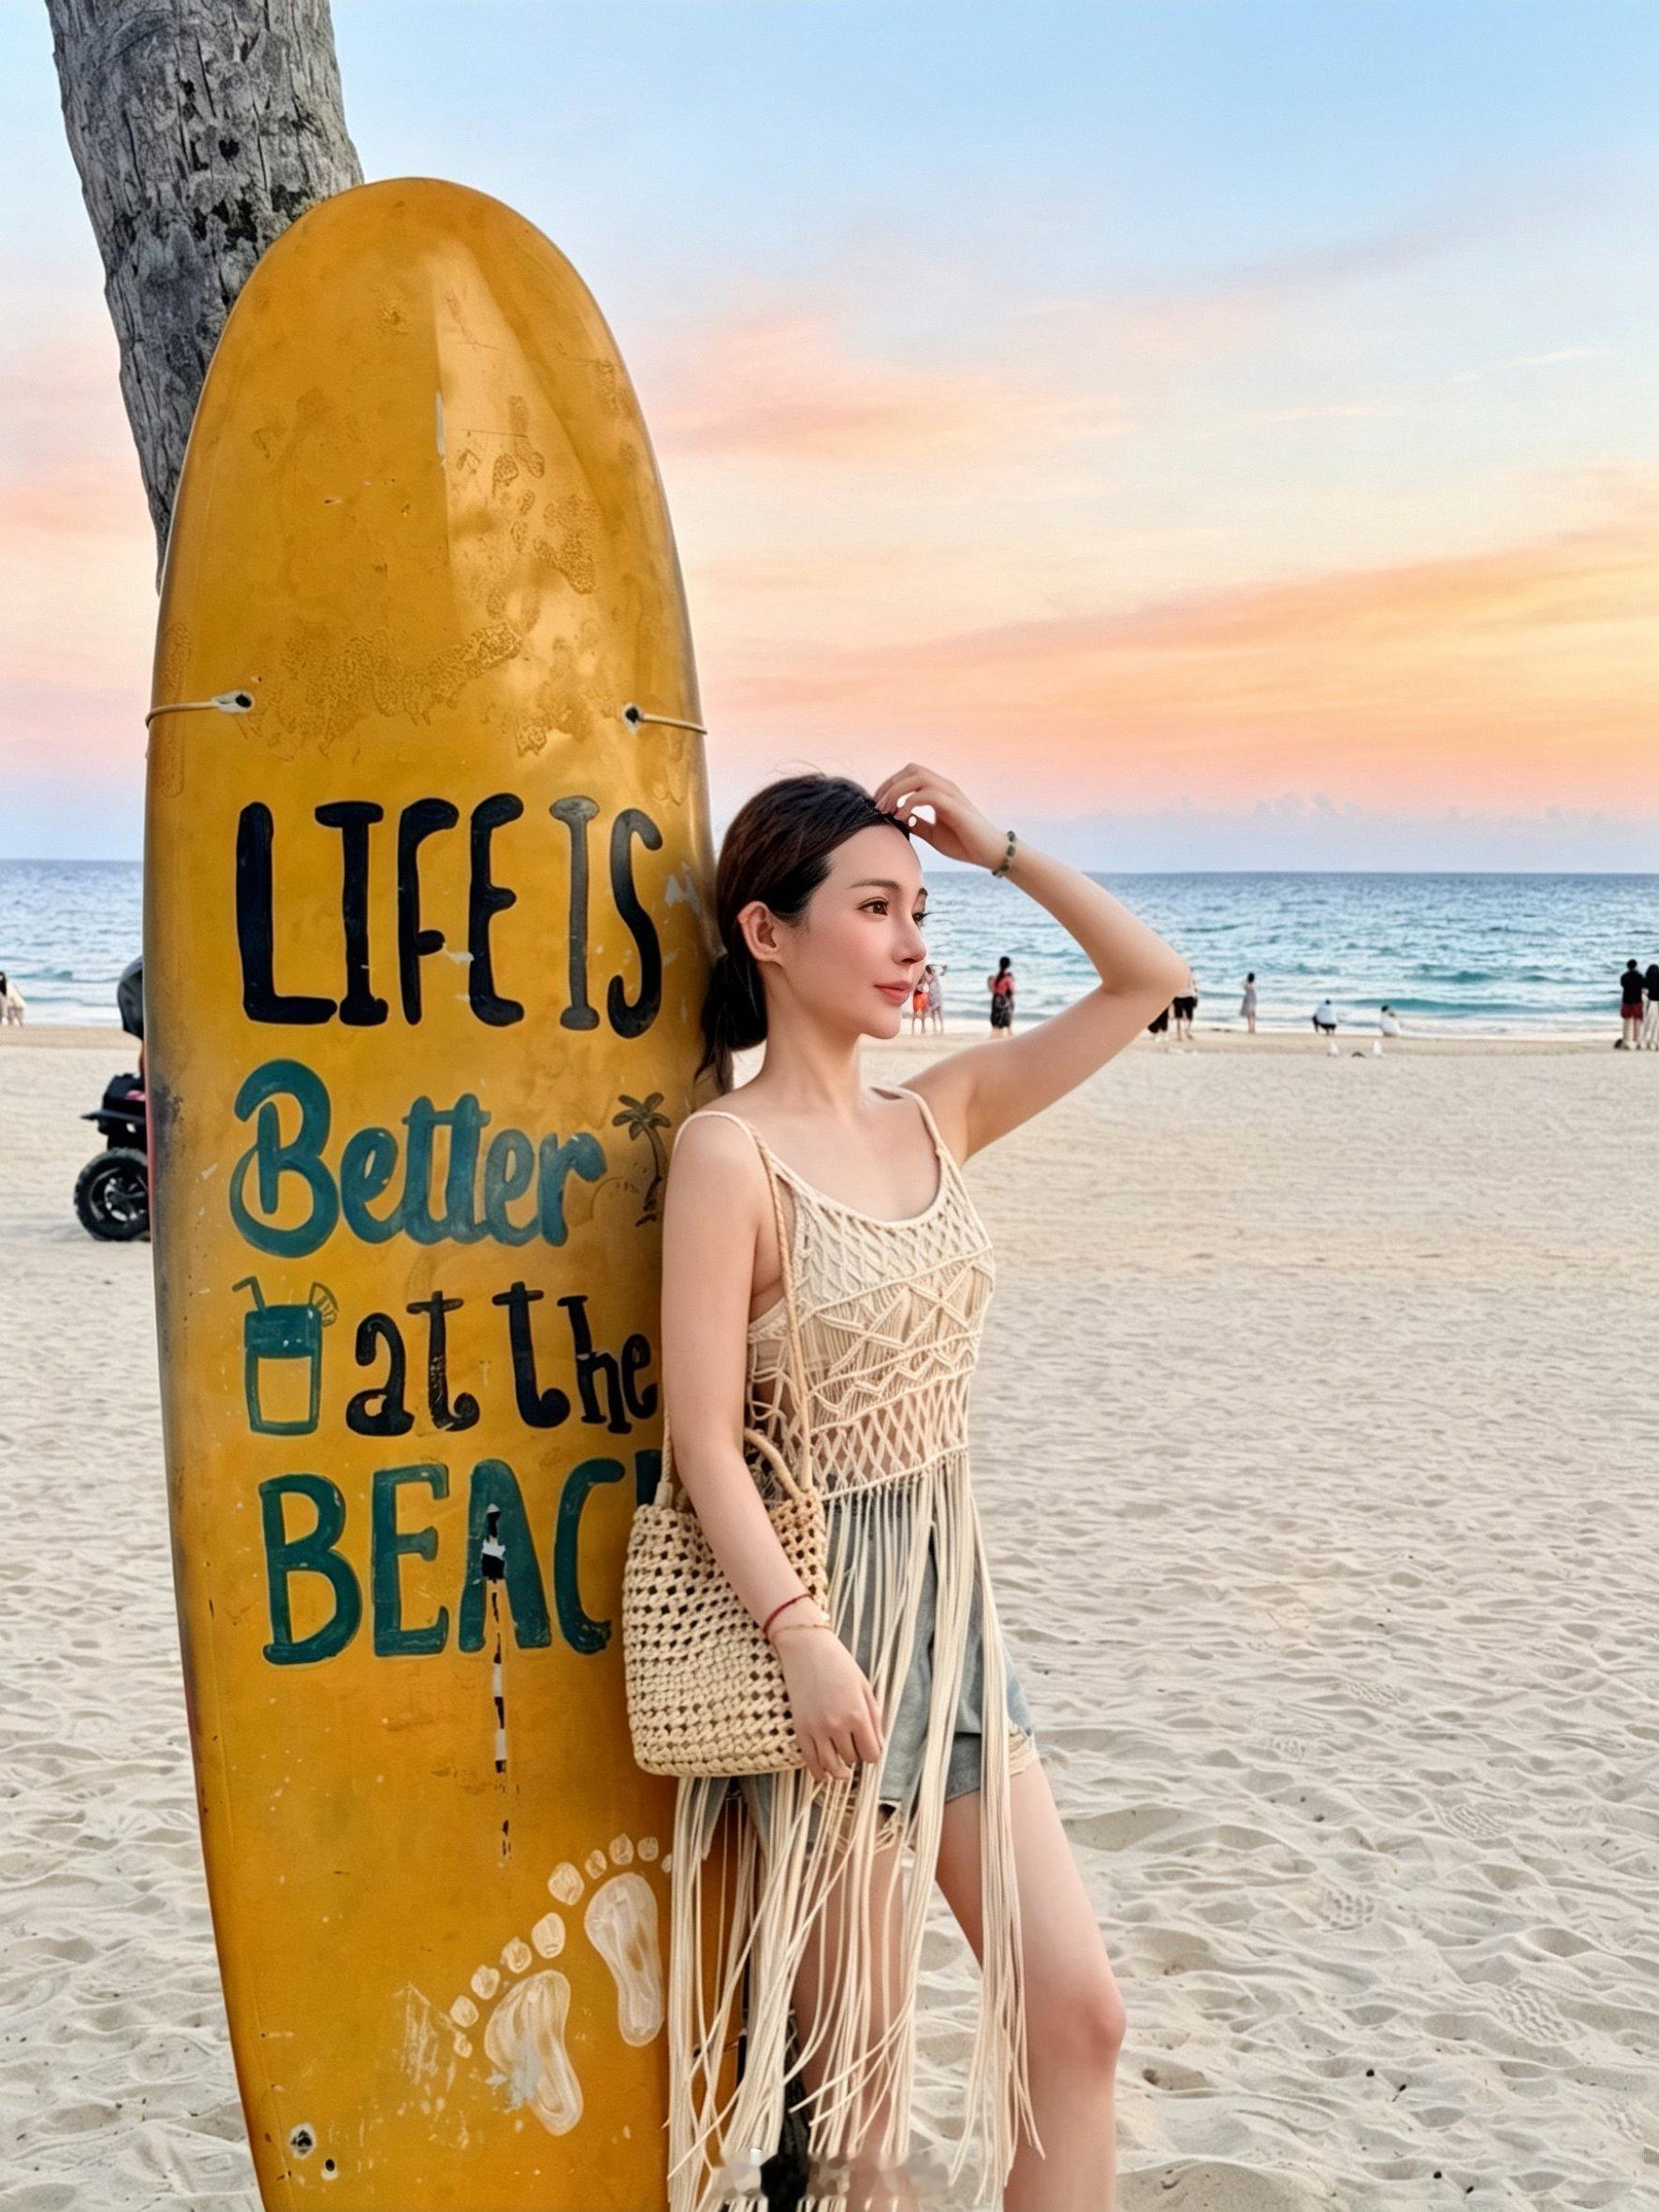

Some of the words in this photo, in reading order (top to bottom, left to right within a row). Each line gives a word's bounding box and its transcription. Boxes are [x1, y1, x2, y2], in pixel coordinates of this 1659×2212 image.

[236, 793, 525, 1026] LIFE
[549, 794, 663, 1040] IS
[229, 1058, 607, 1259] Better
[345, 1290, 480, 1436] at
[492, 1282, 658, 1433] the
[258, 1449, 662, 1666] BEAC
